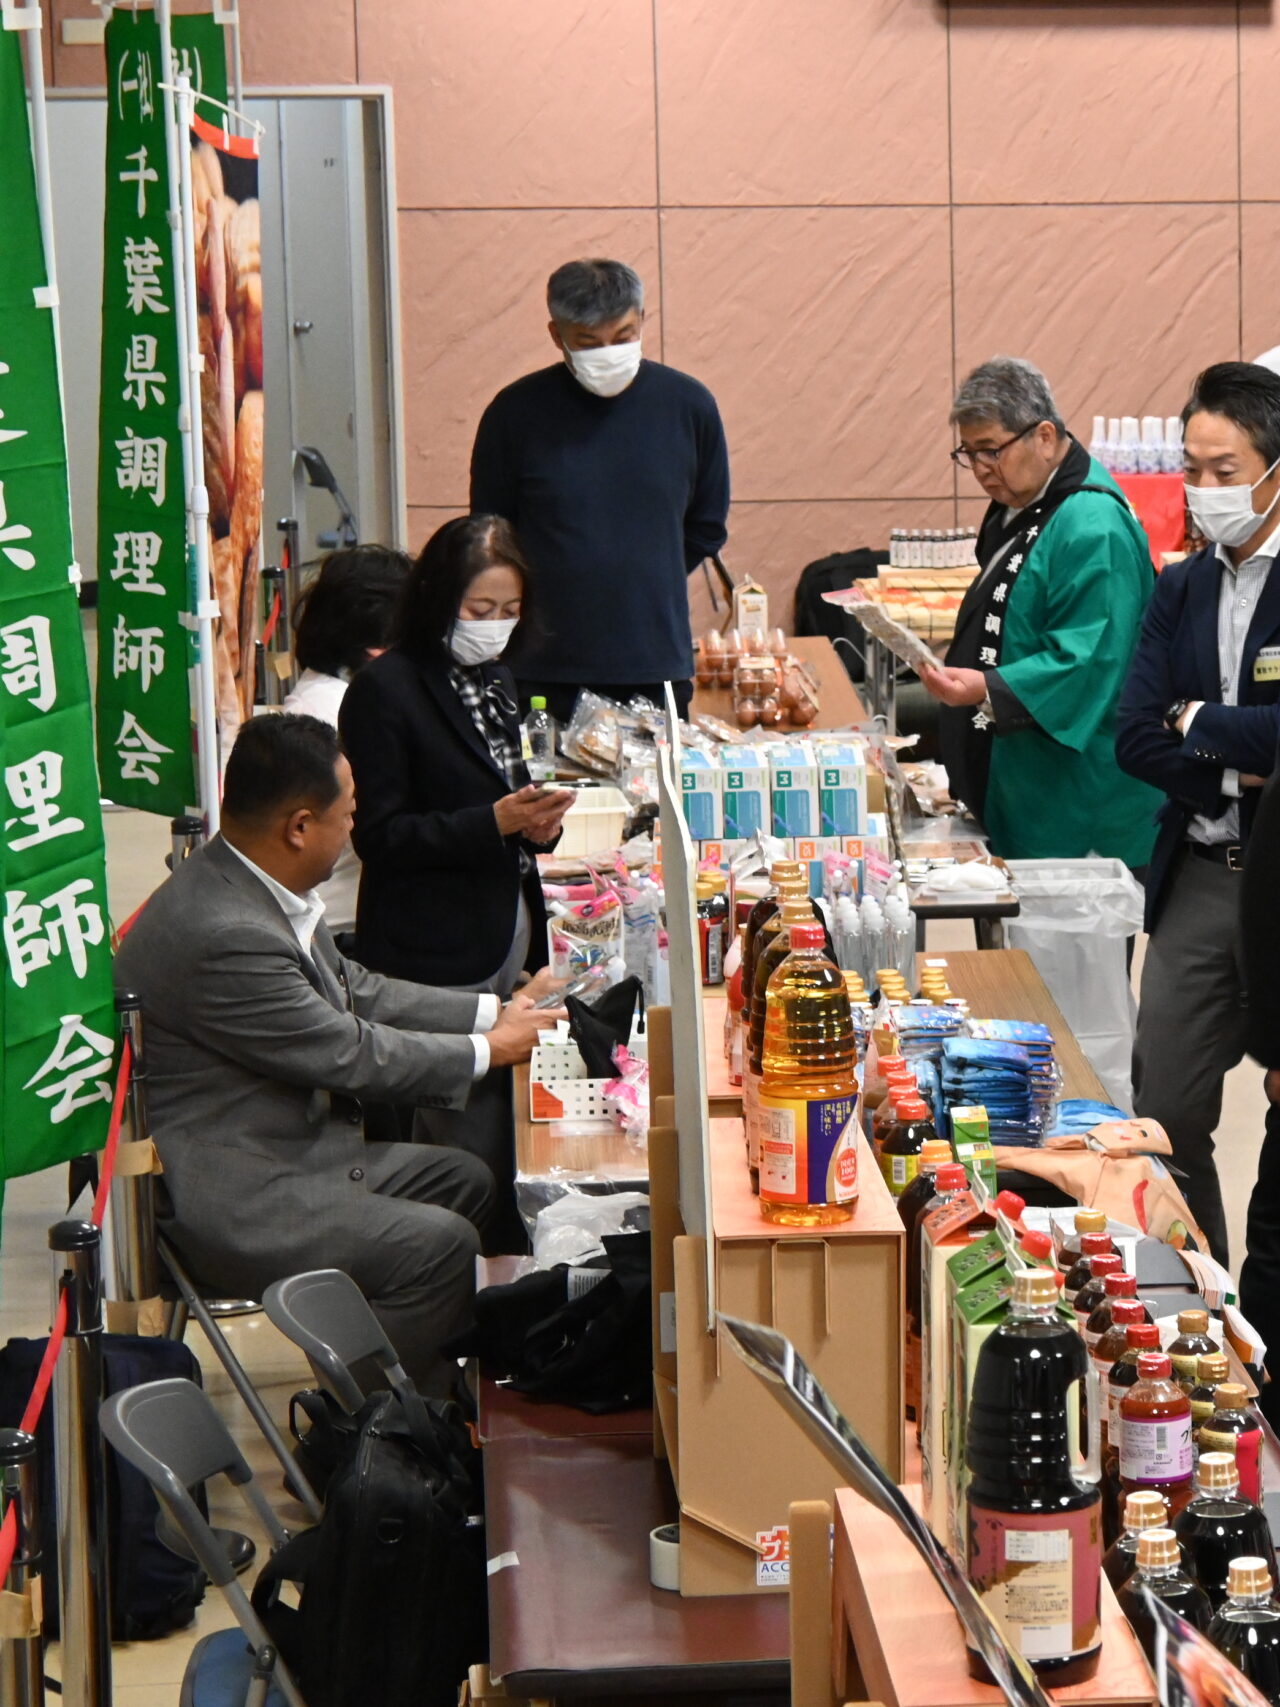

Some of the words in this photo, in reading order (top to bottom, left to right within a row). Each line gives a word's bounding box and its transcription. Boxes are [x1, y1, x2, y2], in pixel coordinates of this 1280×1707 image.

[110, 144, 174, 786] 千葉県調理師会
[971, 525, 1038, 730] 千葉県調理会
